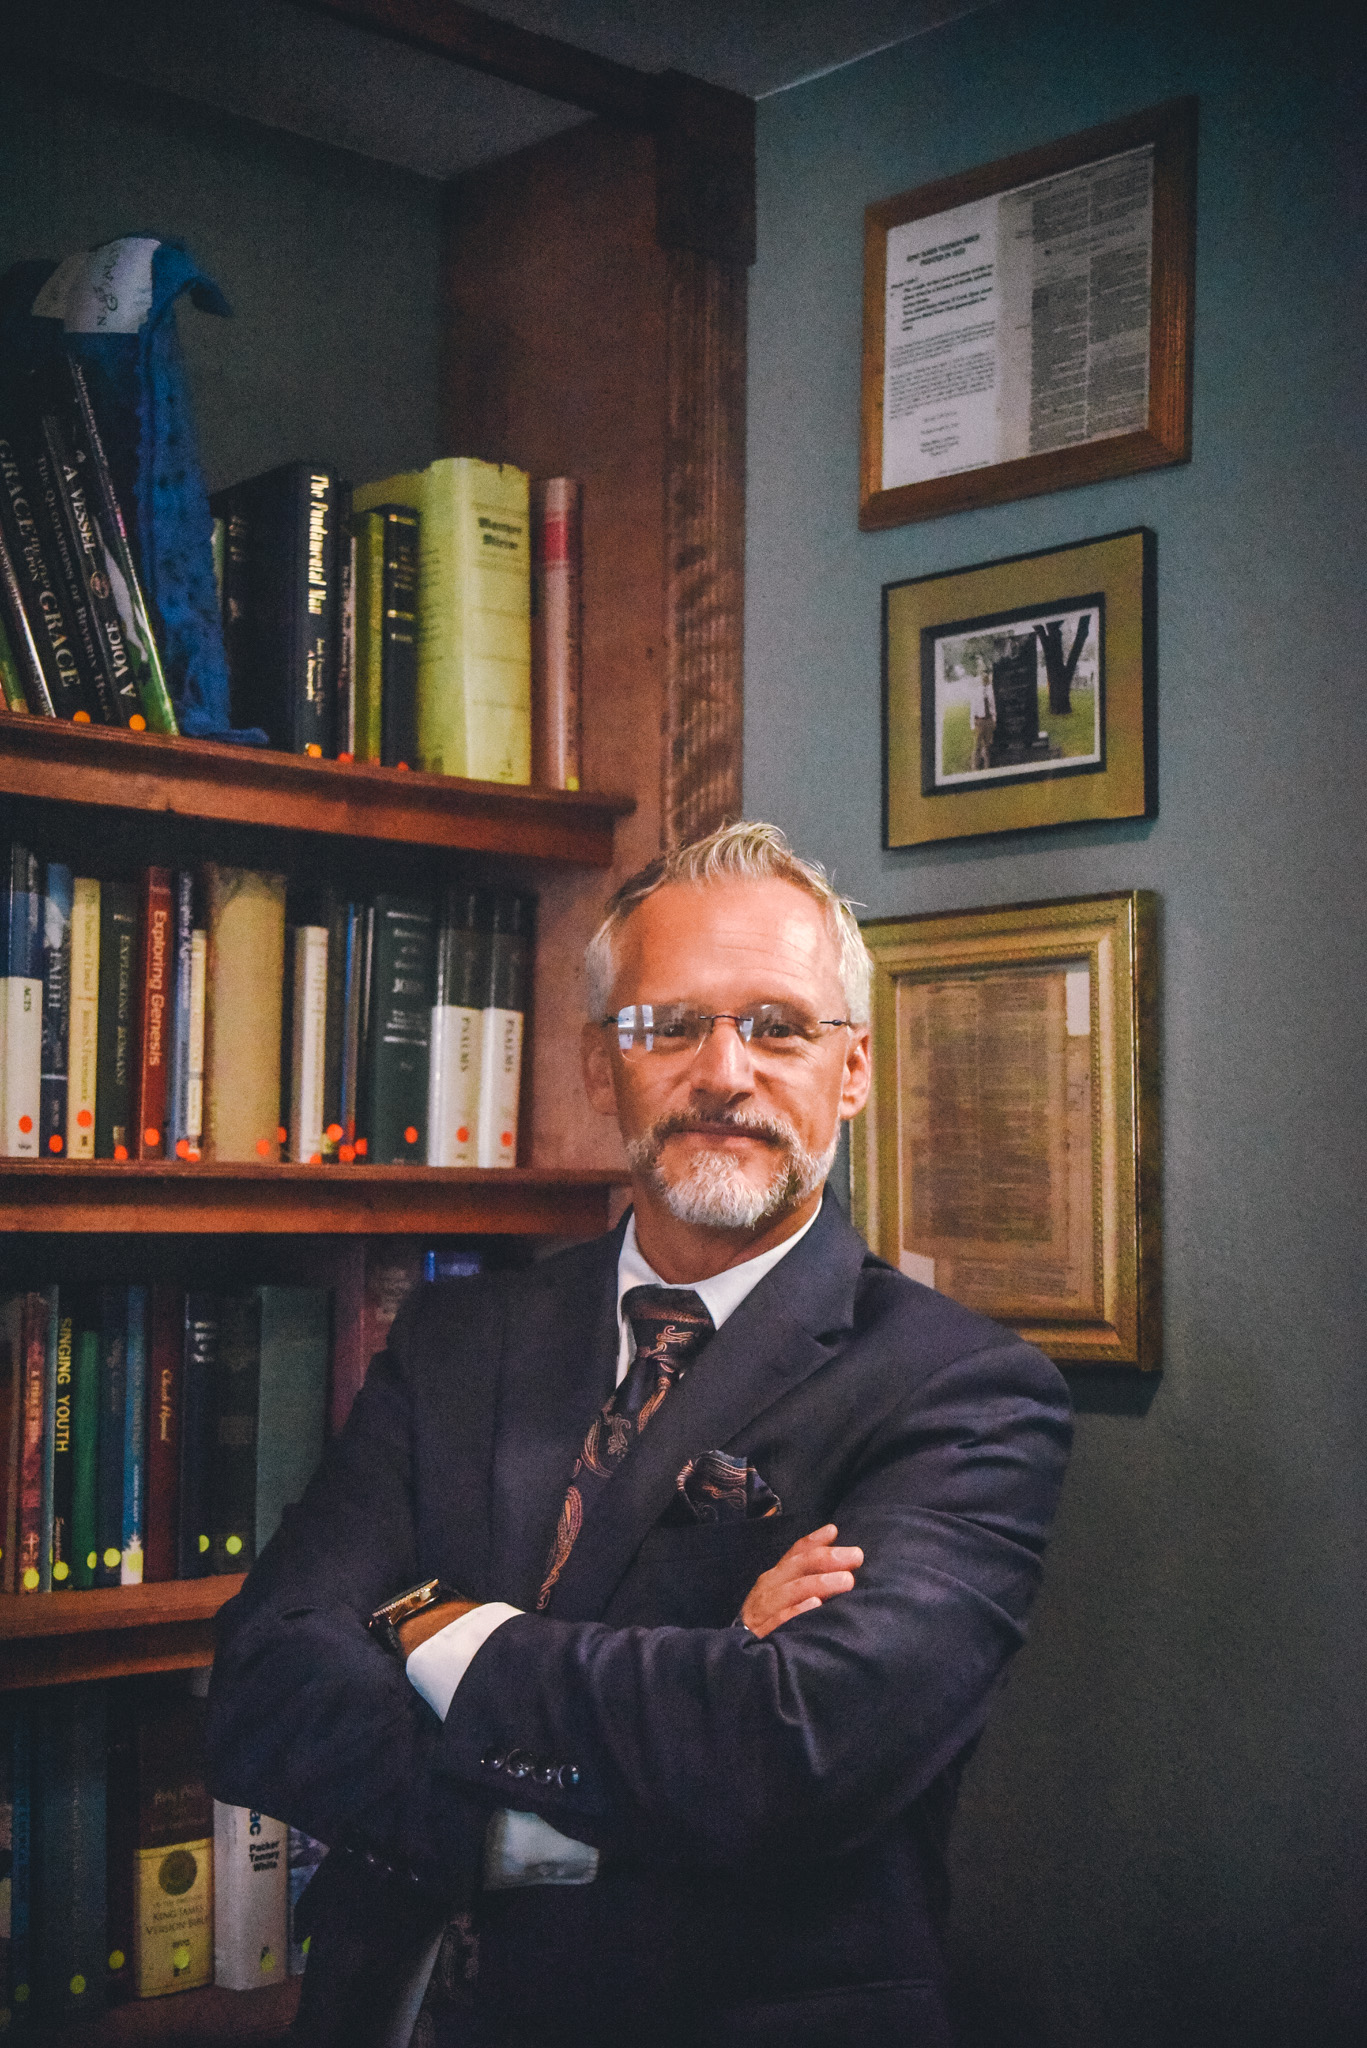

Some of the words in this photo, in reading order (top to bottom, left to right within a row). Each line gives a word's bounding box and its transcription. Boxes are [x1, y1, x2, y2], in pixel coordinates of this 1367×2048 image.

[0, 440, 37, 537] GRACE
[63, 463, 78, 483] A
[310, 474, 330, 498] The
[45, 488, 74, 580] QUOTATIONS
[69, 487, 96, 555] VESSEL
[307, 502, 329, 587] Fundamental
[39, 589, 81, 688] GRACE
[104, 619, 130, 678] VOICE
[117, 934, 131, 1020] EXPLORING
[148, 909, 168, 991] Exploring
[23, 987, 31, 1012] ACTS
[48, 951, 61, 1009] FAITH
[116, 1026, 127, 1087] ROMANS
[149, 994, 165, 1067] Genesis
[460, 1017, 471, 1073] PSALMS
[504, 1018, 515, 1074] PSALMS
[57, 1317, 73, 1385] SINGING
[54, 1394, 71, 1453] YOUTH
[249, 1840, 280, 1853] Packer
[253, 1860, 278, 1872] White
[152, 1906, 176, 1922] KING
